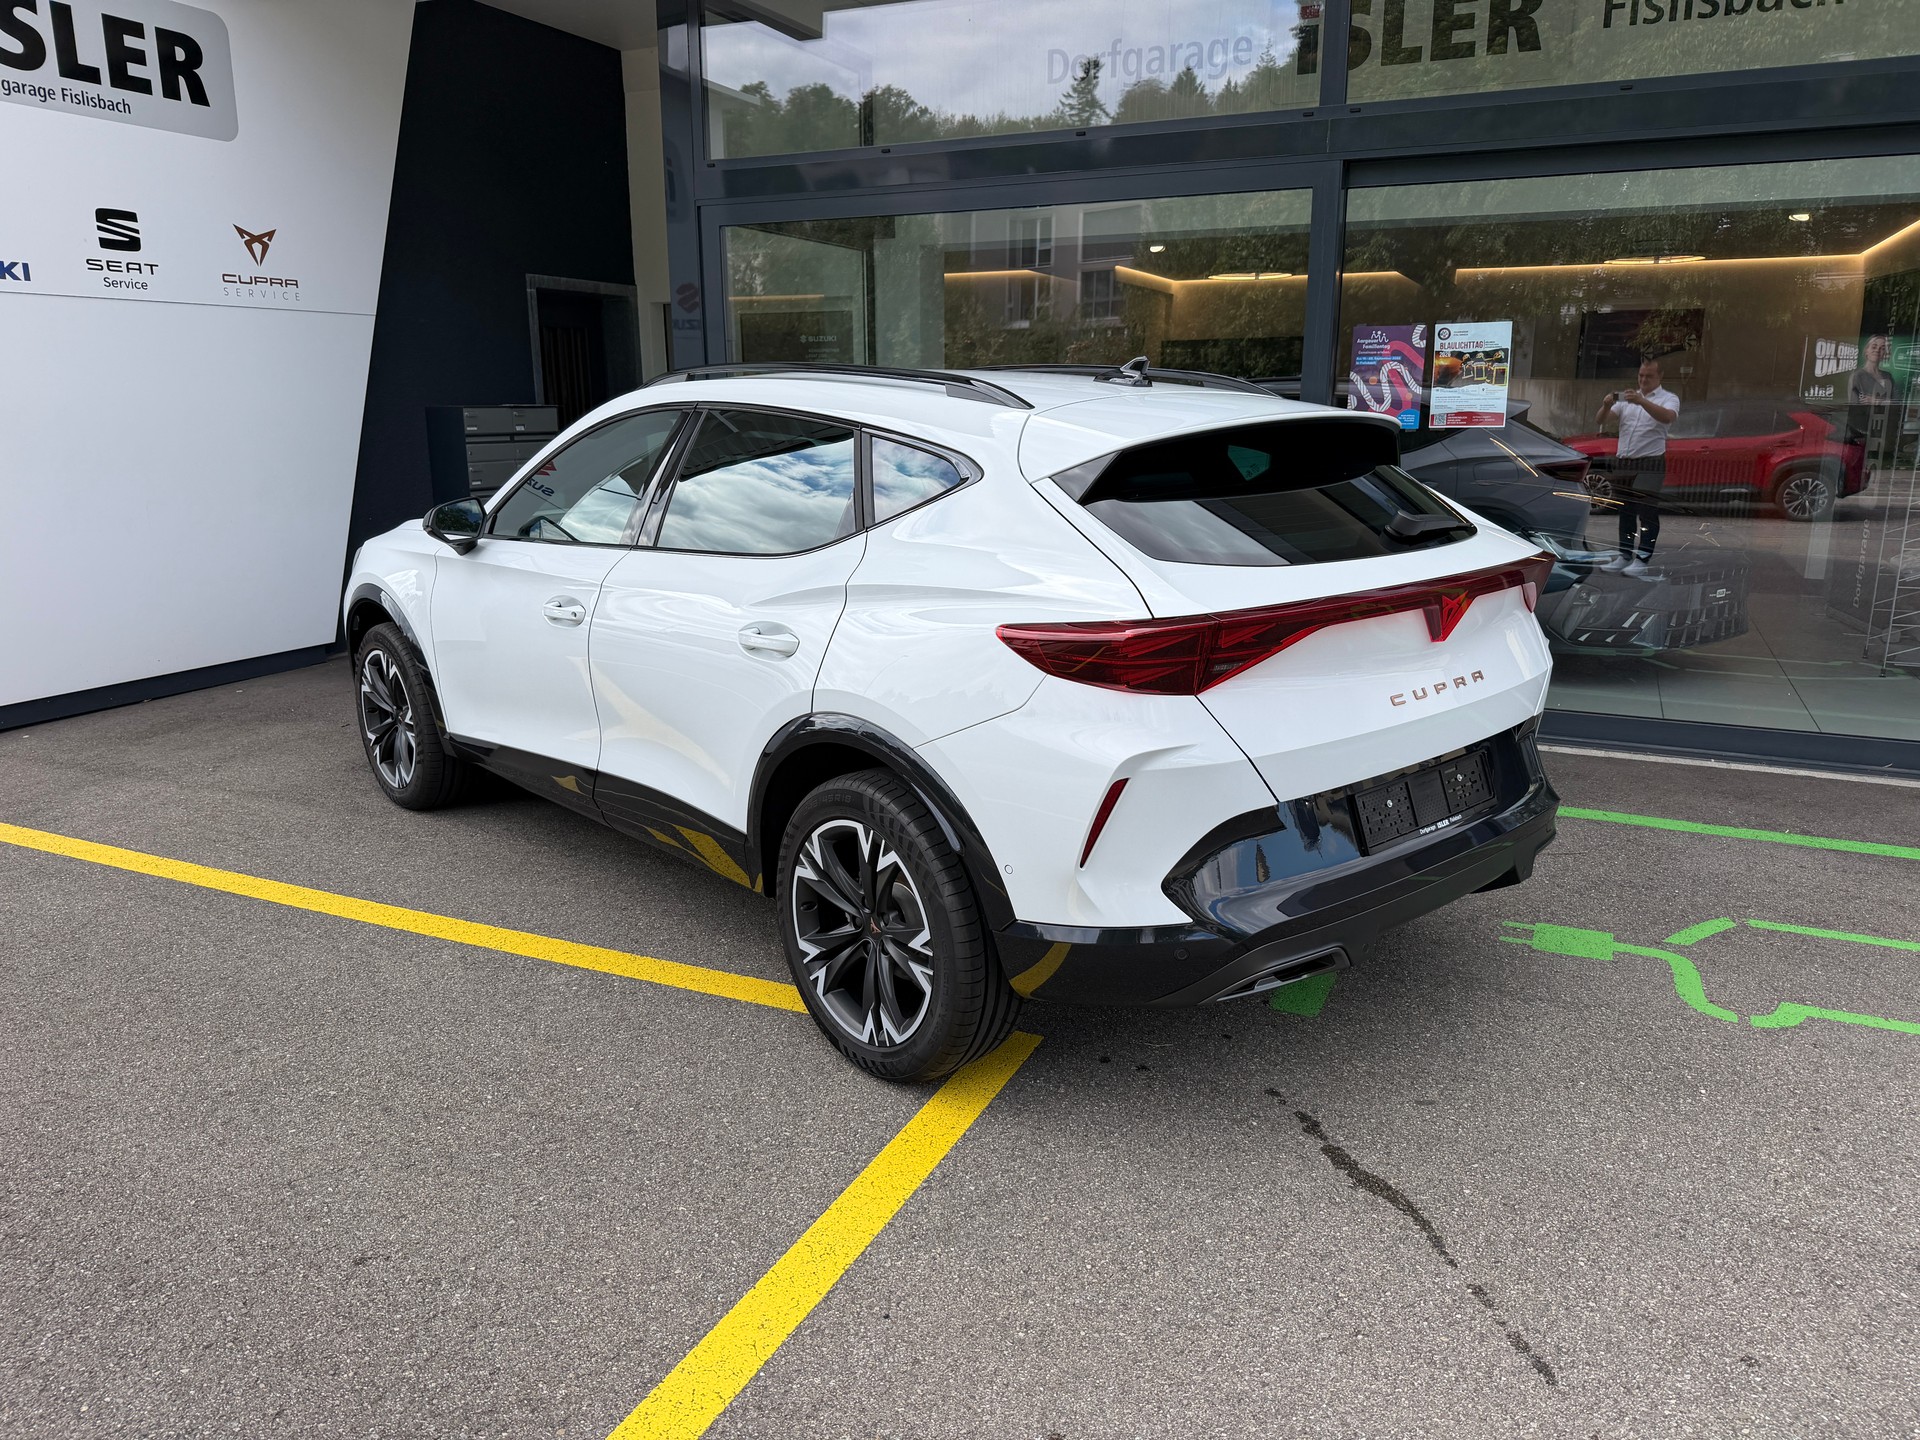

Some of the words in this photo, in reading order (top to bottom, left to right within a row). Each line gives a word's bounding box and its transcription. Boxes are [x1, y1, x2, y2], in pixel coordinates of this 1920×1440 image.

[1047, 35, 1253, 88] Dorfgarage
[61, 88, 132, 114] Fislisbach
[86, 259, 159, 275] SEAT
[103, 277, 148, 290] Service
[222, 274, 299, 288] CUPRA
[223, 287, 300, 301] SERVICE
[808, 335, 837, 343] SUZUKI
[1439, 340, 1484, 350] BLAULICHTTAG
[1390, 670, 1485, 706] CUPRA
